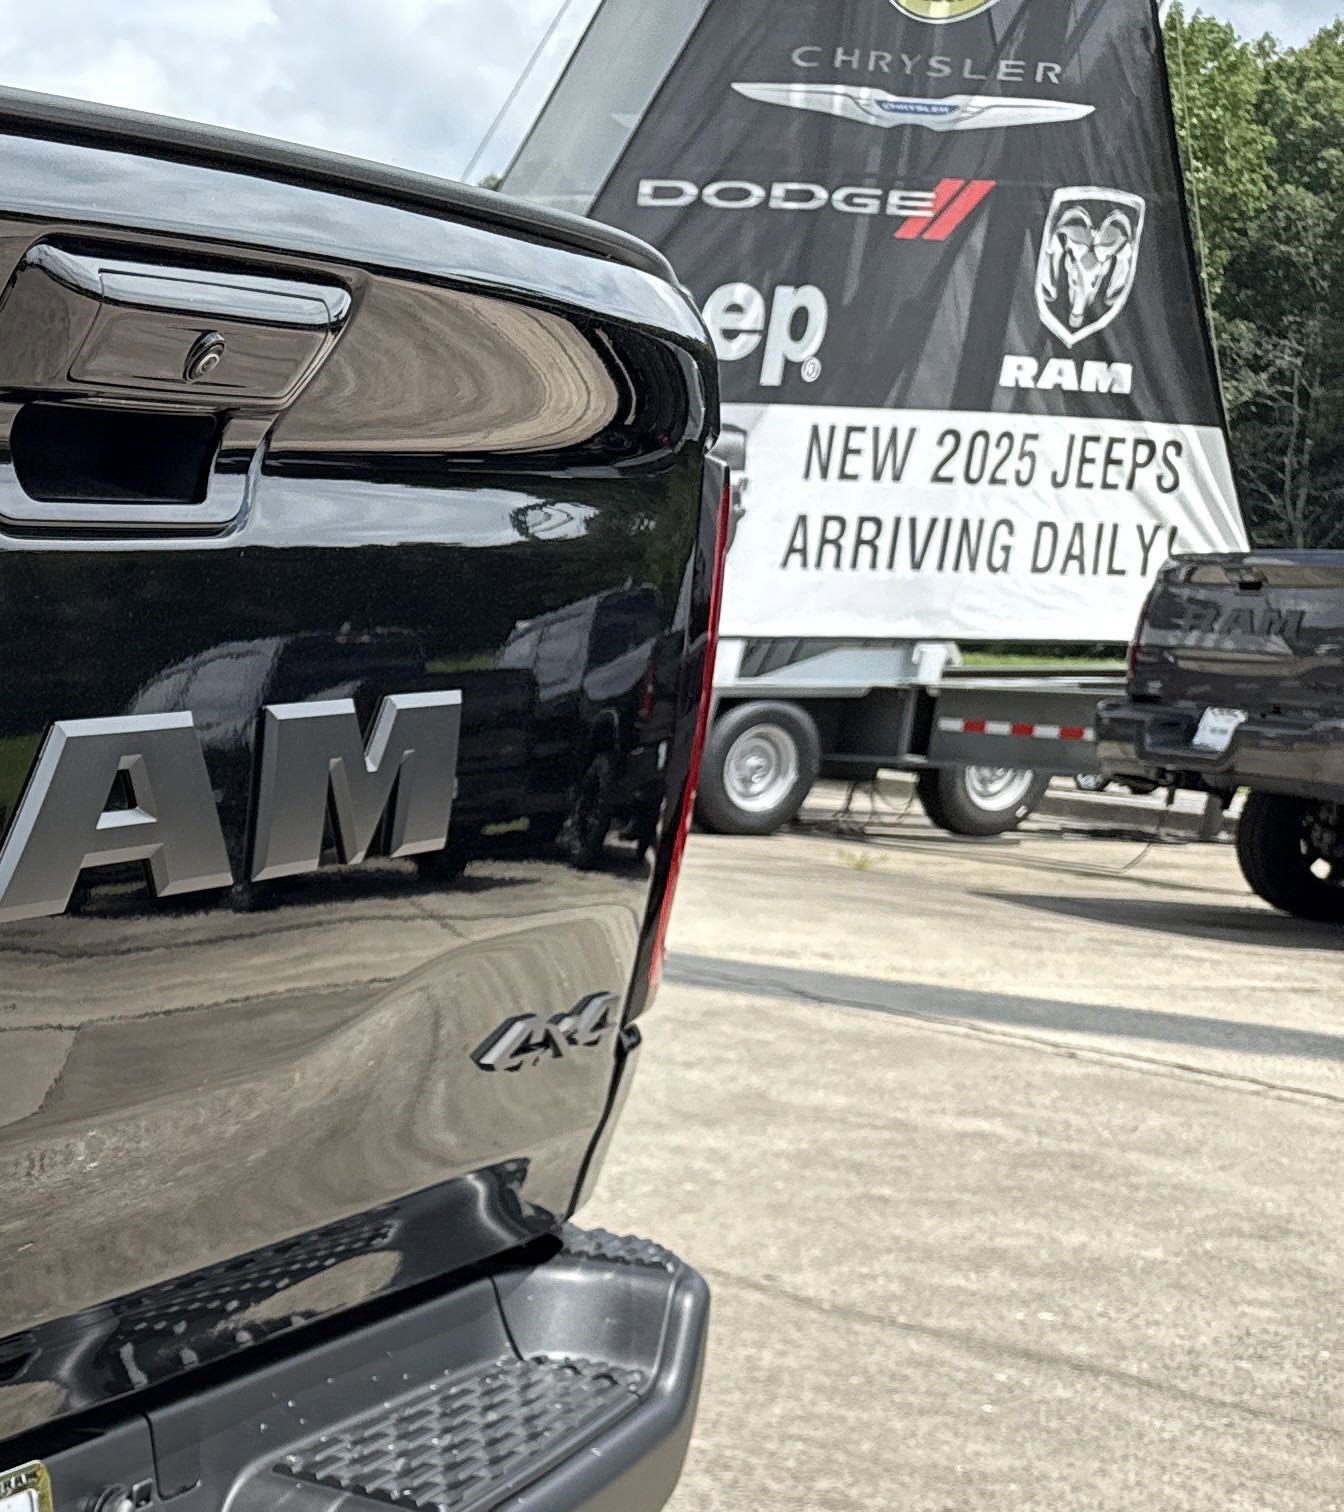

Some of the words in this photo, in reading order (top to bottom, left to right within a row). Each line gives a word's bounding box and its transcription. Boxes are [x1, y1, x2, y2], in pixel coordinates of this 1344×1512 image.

[791, 46, 1064, 85] CHRYSLER
[637, 179, 937, 218] DODGE
[703, 282, 828, 386] eep
[999, 354, 1133, 394] RAM
[803, 424, 916, 482] NEW
[930, 428, 1040, 487] 2025
[1051, 434, 1183, 494] JEEPS
[779, 514, 1014, 575] ARRIVING
[1184, 598, 1307, 638] RAM
